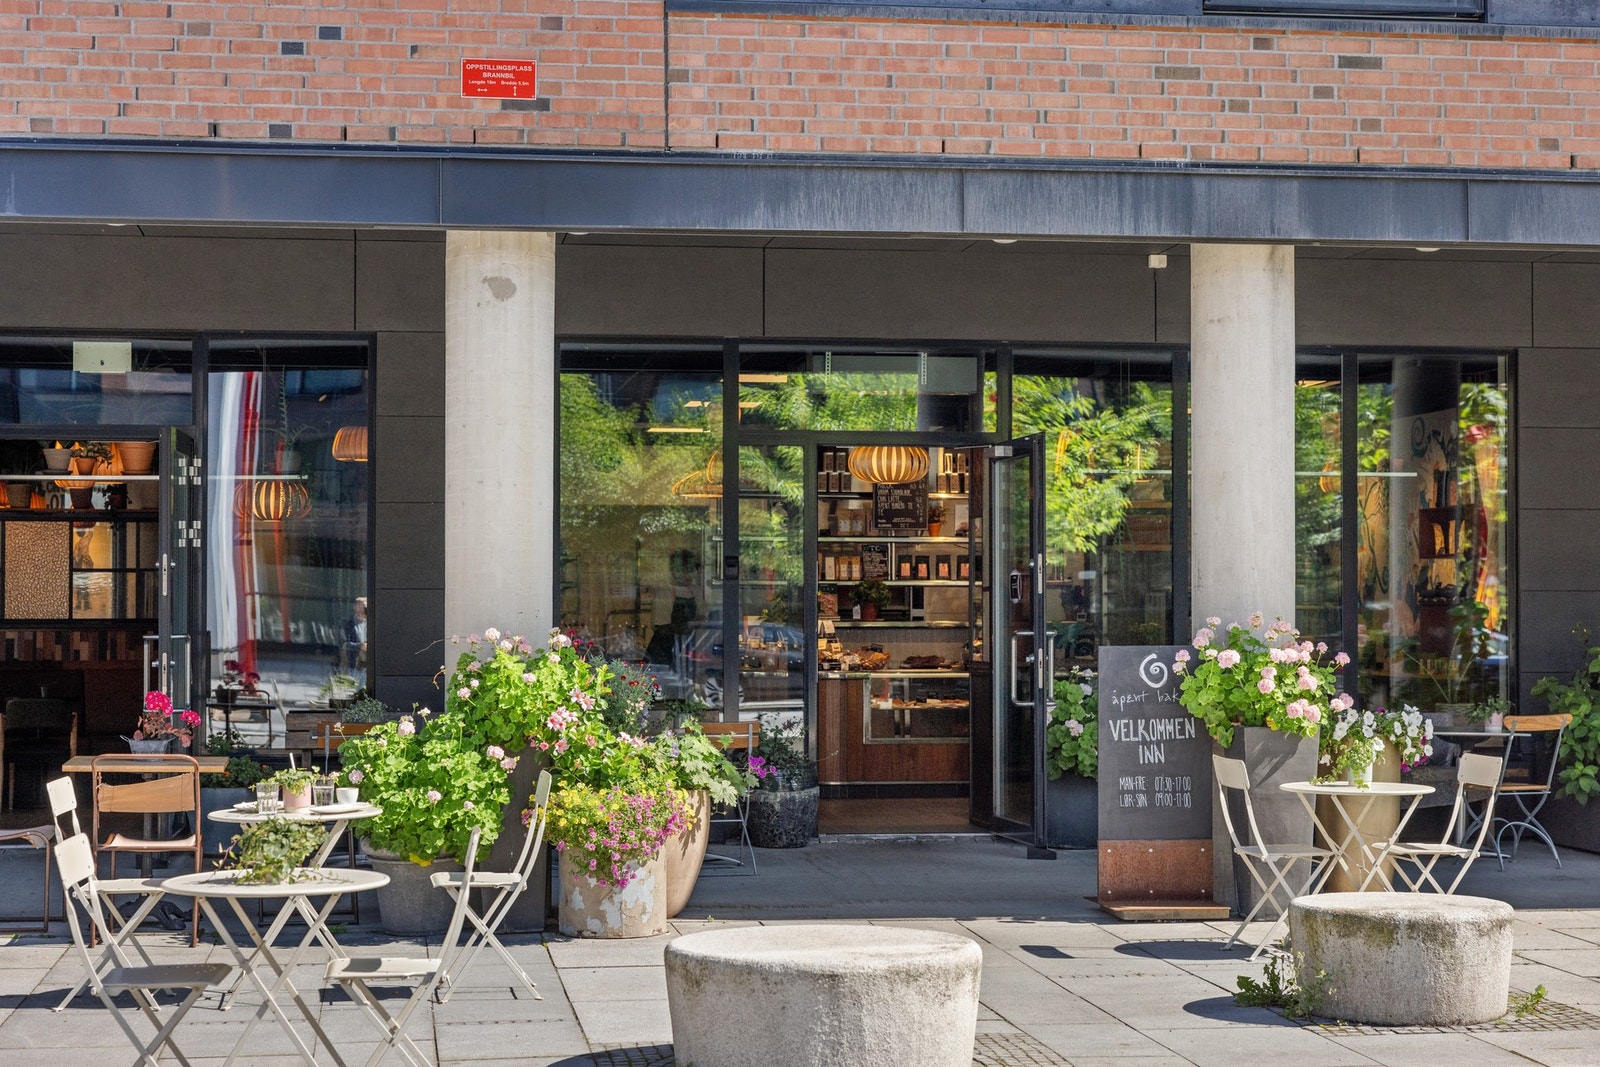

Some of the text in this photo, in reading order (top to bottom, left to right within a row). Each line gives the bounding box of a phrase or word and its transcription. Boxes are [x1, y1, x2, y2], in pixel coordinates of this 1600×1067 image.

[465, 63, 533, 72] OPPSTILLINGSPLASS
[1157, 687, 1181, 703] bak
[1108, 717, 1196, 742] VELKOMMEN
[1139, 743, 1165, 765] INN
